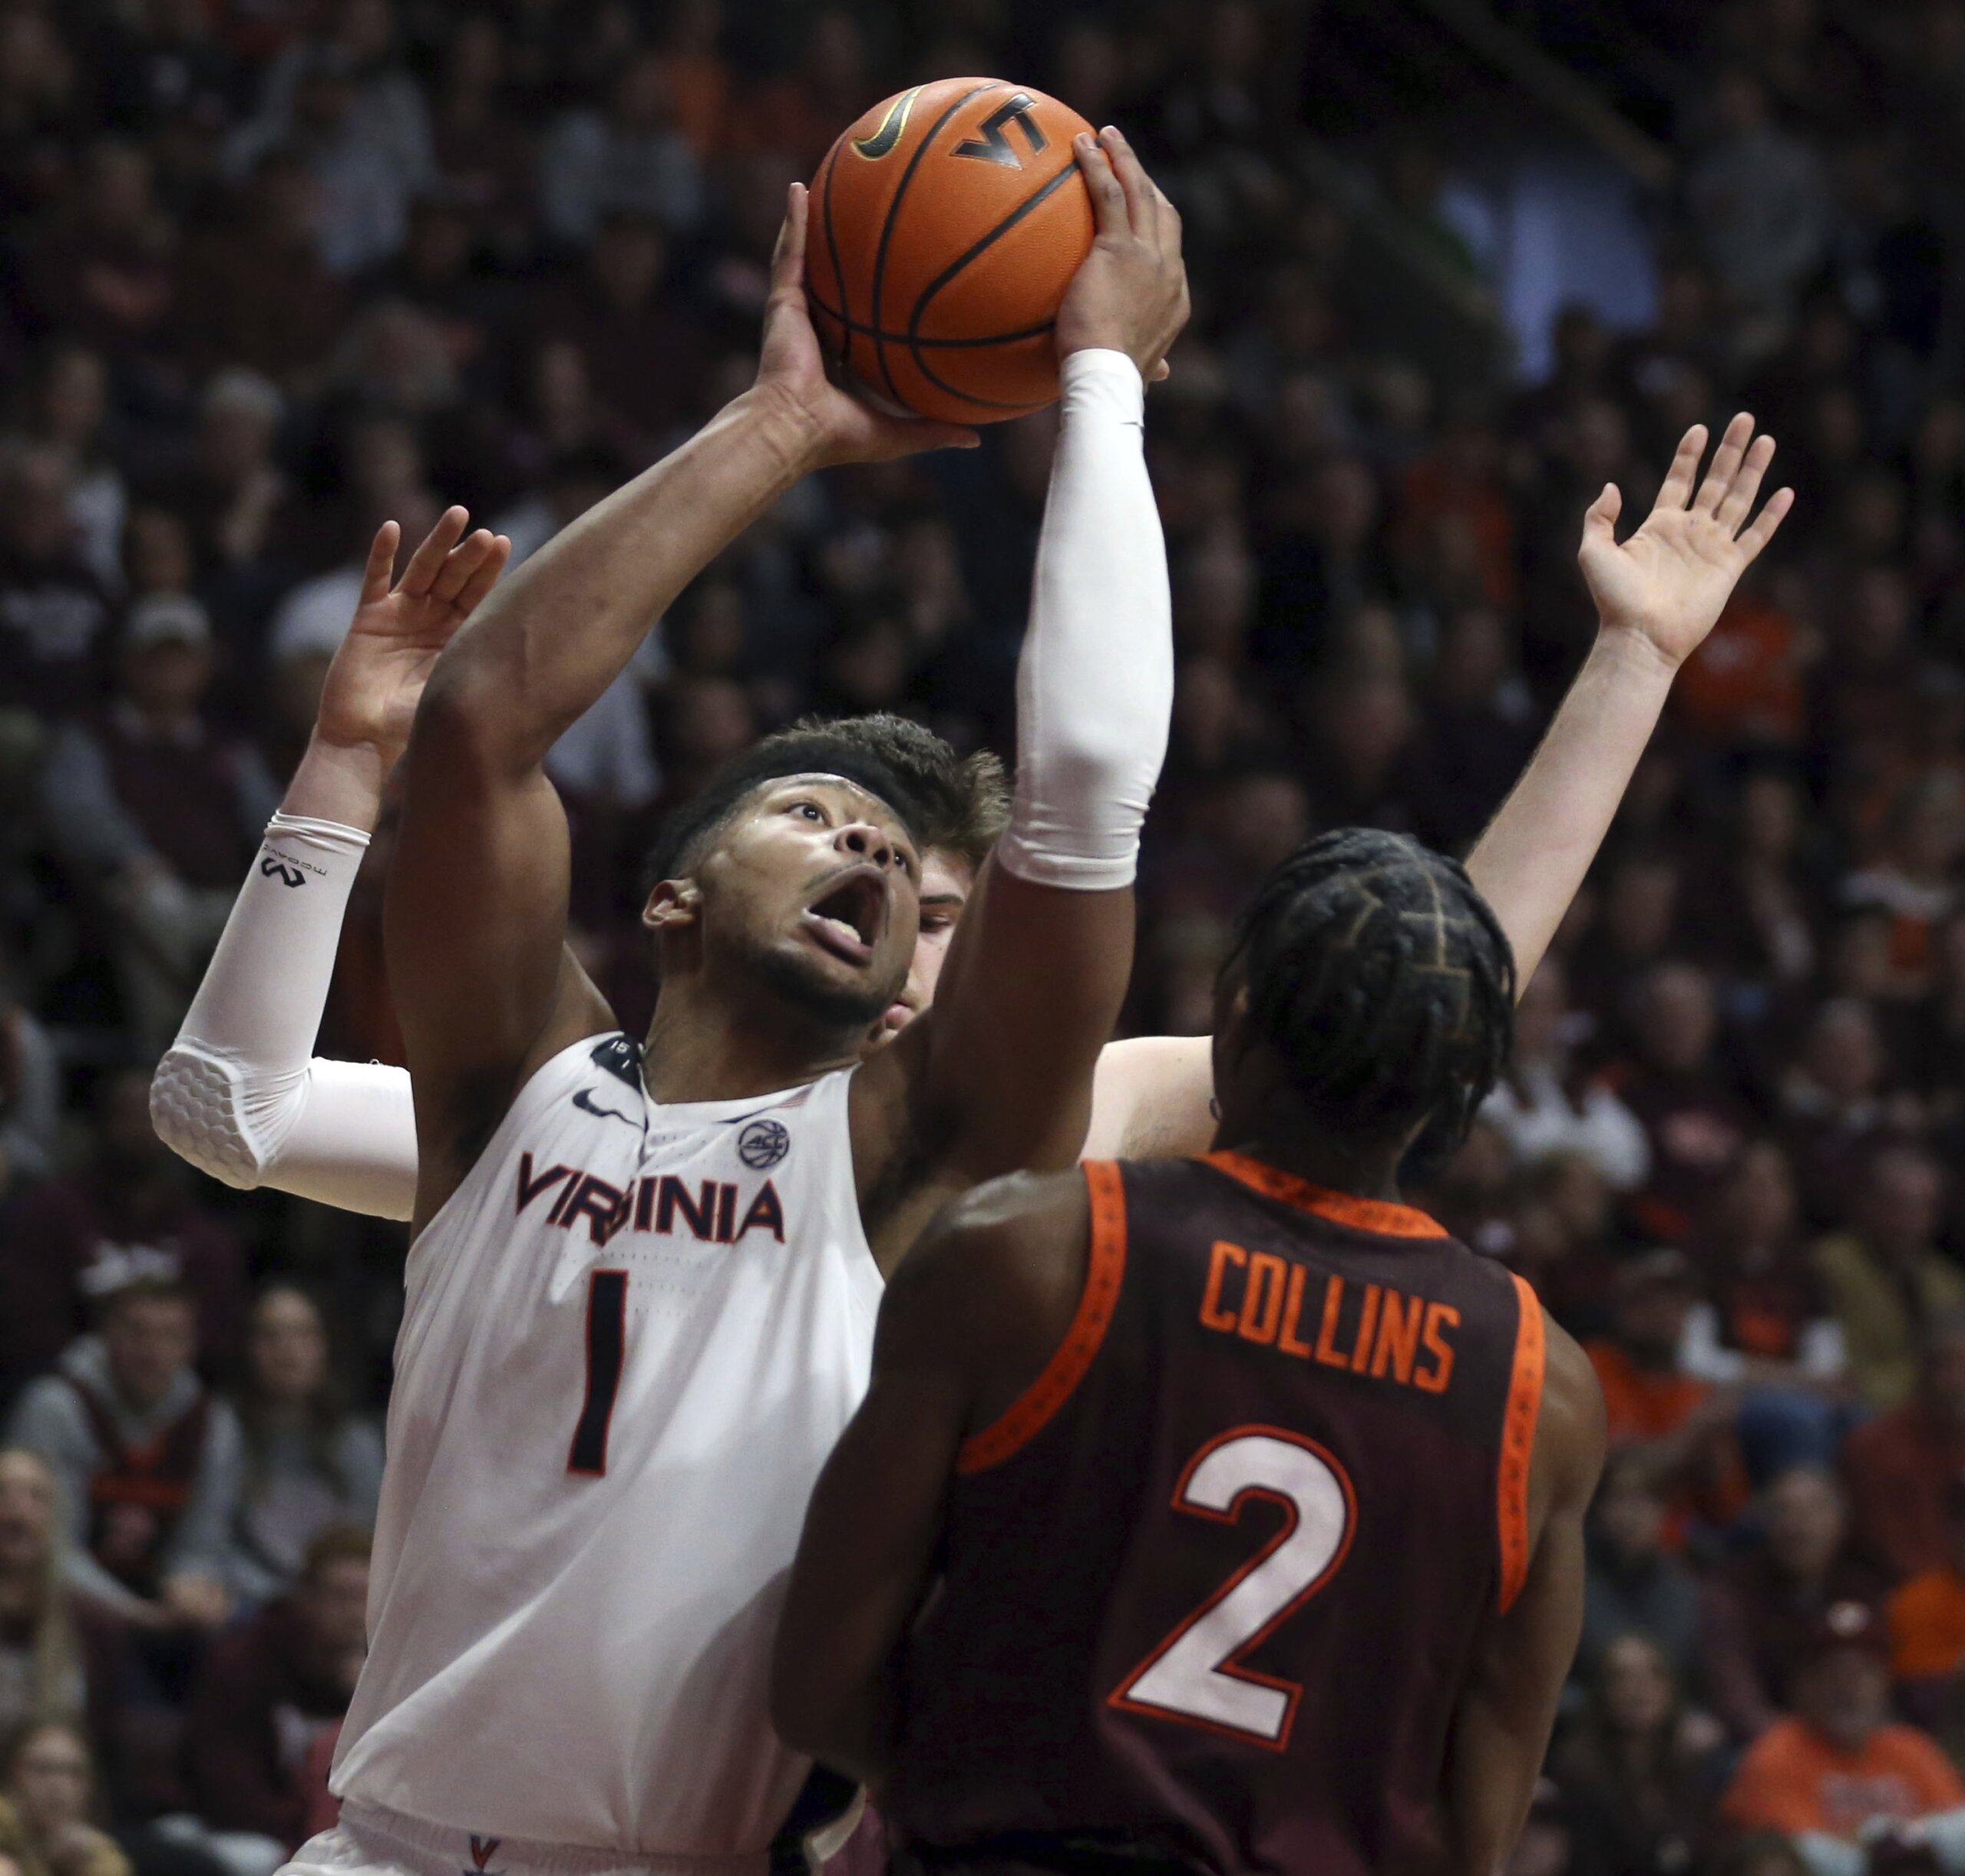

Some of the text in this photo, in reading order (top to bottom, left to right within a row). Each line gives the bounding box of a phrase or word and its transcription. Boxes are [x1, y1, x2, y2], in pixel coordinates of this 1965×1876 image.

[263, 844, 328, 876] MCDAV
[566, 1269, 629, 1478] 1
[1199, 1240, 1461, 1393] COLLINS
[1107, 1424, 1358, 1751] 2
